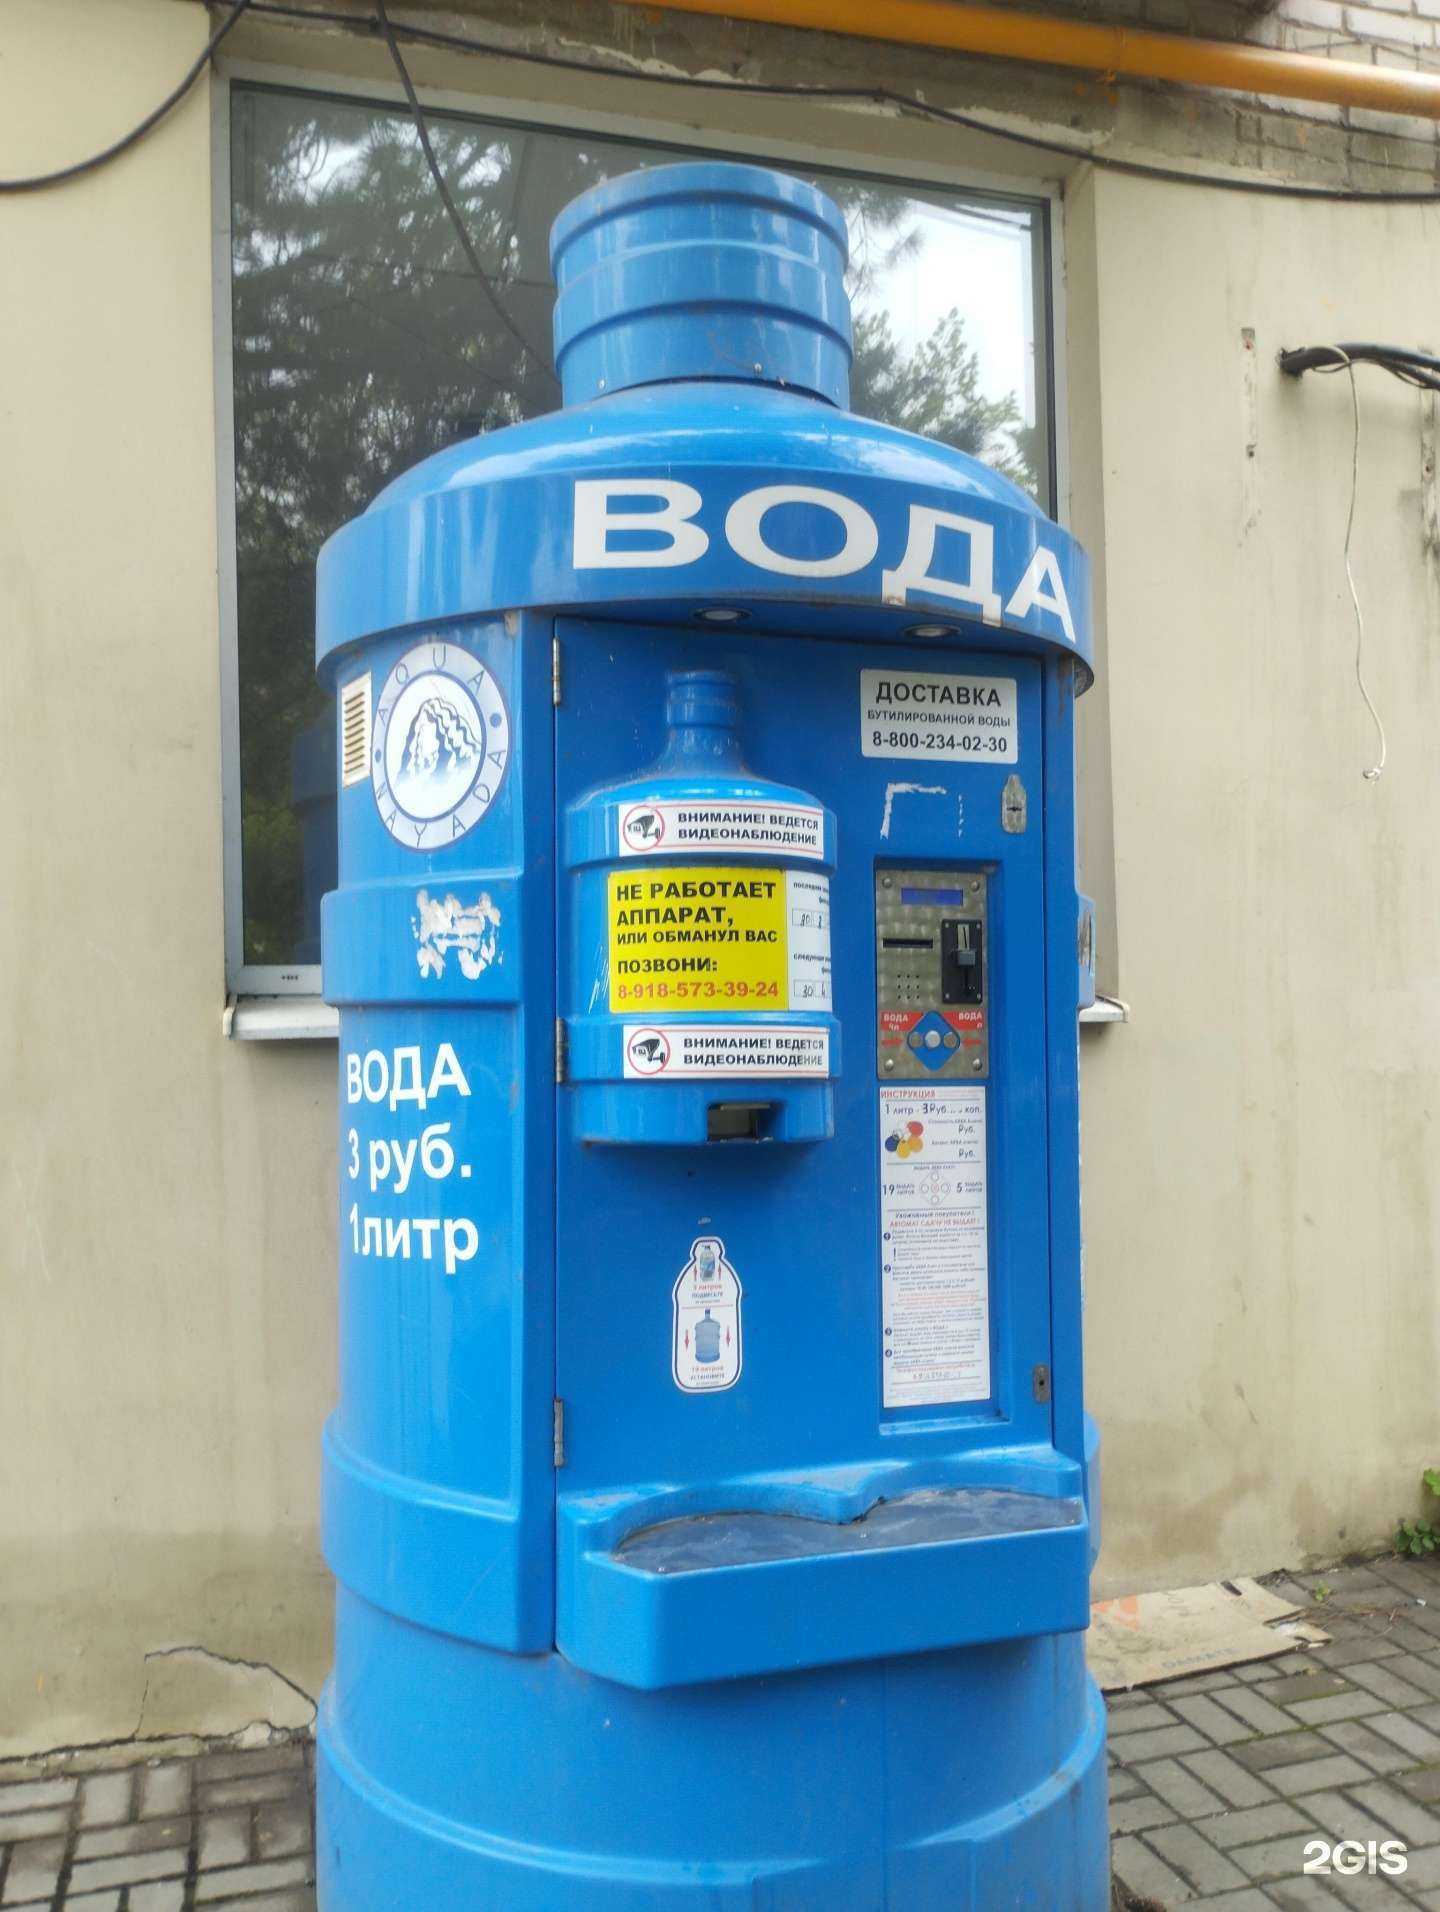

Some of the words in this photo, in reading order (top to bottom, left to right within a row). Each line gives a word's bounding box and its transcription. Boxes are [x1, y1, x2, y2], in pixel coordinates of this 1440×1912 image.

[573, 479, 1076, 643] ВОДА
[876, 681, 1001, 707] ДОСТАВКА
[867, 709, 975, 725] БУТИЛИРОВАННОЙ
[978, 715, 1010, 729] ВОДЫ
[872, 731, 1007, 752] 8-800-234-02-30
[678, 813, 765, 825] ВНИМАНИЕ!
[770, 815, 818, 829] ВЕДЕТСЯ
[678, 828, 816, 845] ВИДЕОНАБЛЮДЕНИЕ
[617, 884, 642, 901] НЕ
[650, 881, 776, 900] РАБОТАЕТ
[617, 907, 733, 928] АППАРАТ,
[617, 932, 648, 945] ИЛИ
[653, 930, 739, 943] ОБМАНУЛ
[745, 930, 778, 942] ВАС
[617, 958, 718, 974] ПОЗВОНИ:
[618, 981, 779, 999] 8-918-573-39-24
[883, 1013, 908, 1022] ВОДА
[959, 1011, 982, 1021] ВОДА
[684, 1038, 771, 1049] ВНИМАНИЕ!
[776, 1039, 823, 1050] ВЕДЕТСЯ
[684, 1054, 823, 1066] ВИДЕОНАБЛЮДЕНИЕ
[347, 1043, 472, 1111] ВОДА
[881, 1090, 935, 1099] ИНСТРУКЦИЯ
[349, 1128, 359, 1179] 3
[369, 1122, 472, 1193] руб.
